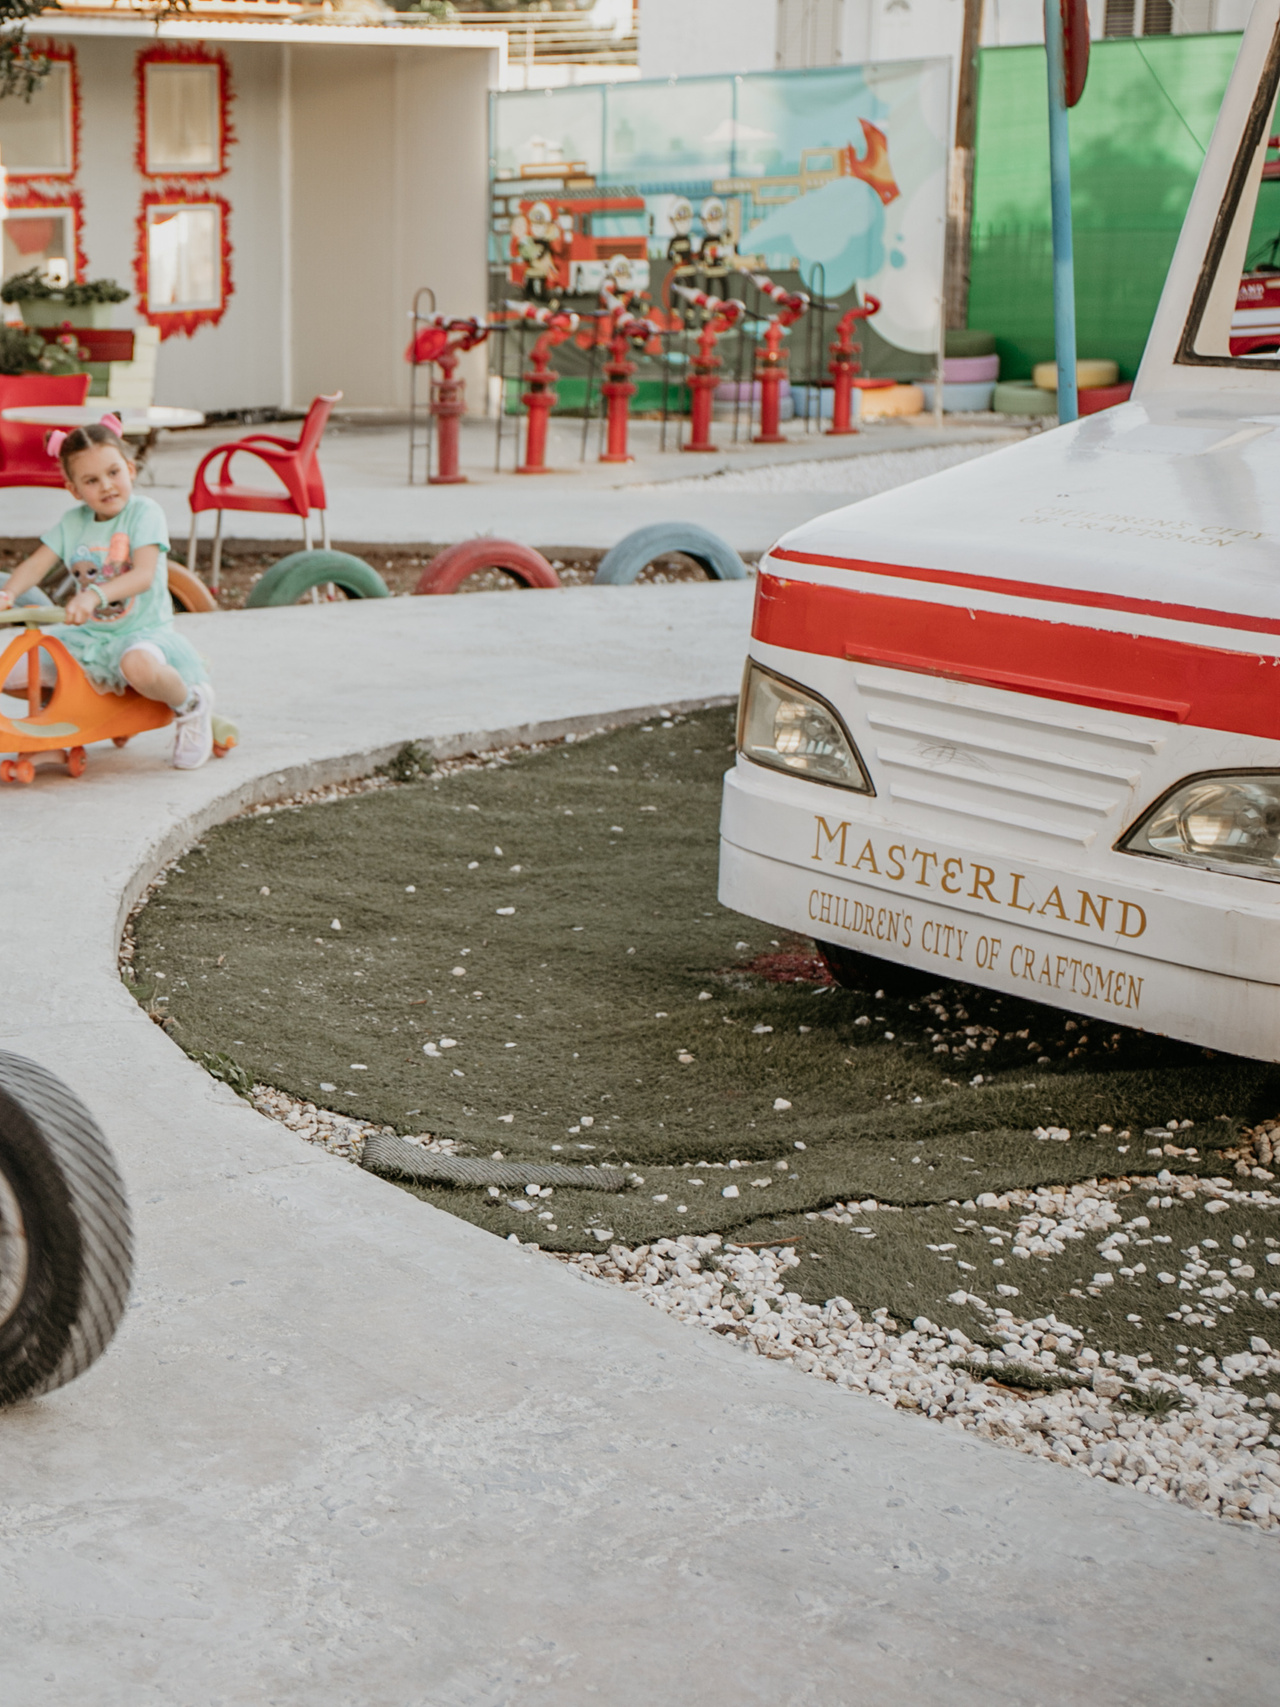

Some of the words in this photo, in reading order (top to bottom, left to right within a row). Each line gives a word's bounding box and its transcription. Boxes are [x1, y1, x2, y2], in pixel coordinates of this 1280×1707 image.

[1019, 515, 1058, 525] OF
[1062, 519, 1235, 548] CRAFTSMEN
[1199, 525, 1269, 540] CITY
[811, 815, 1147, 938] MASTERLAND
[808, 889, 913, 948] CHILDREN'S
[922, 919, 969, 962] CITY
[975, 935, 1002, 970] OF
[1010, 944, 1145, 1010] CRAFTSMEN
